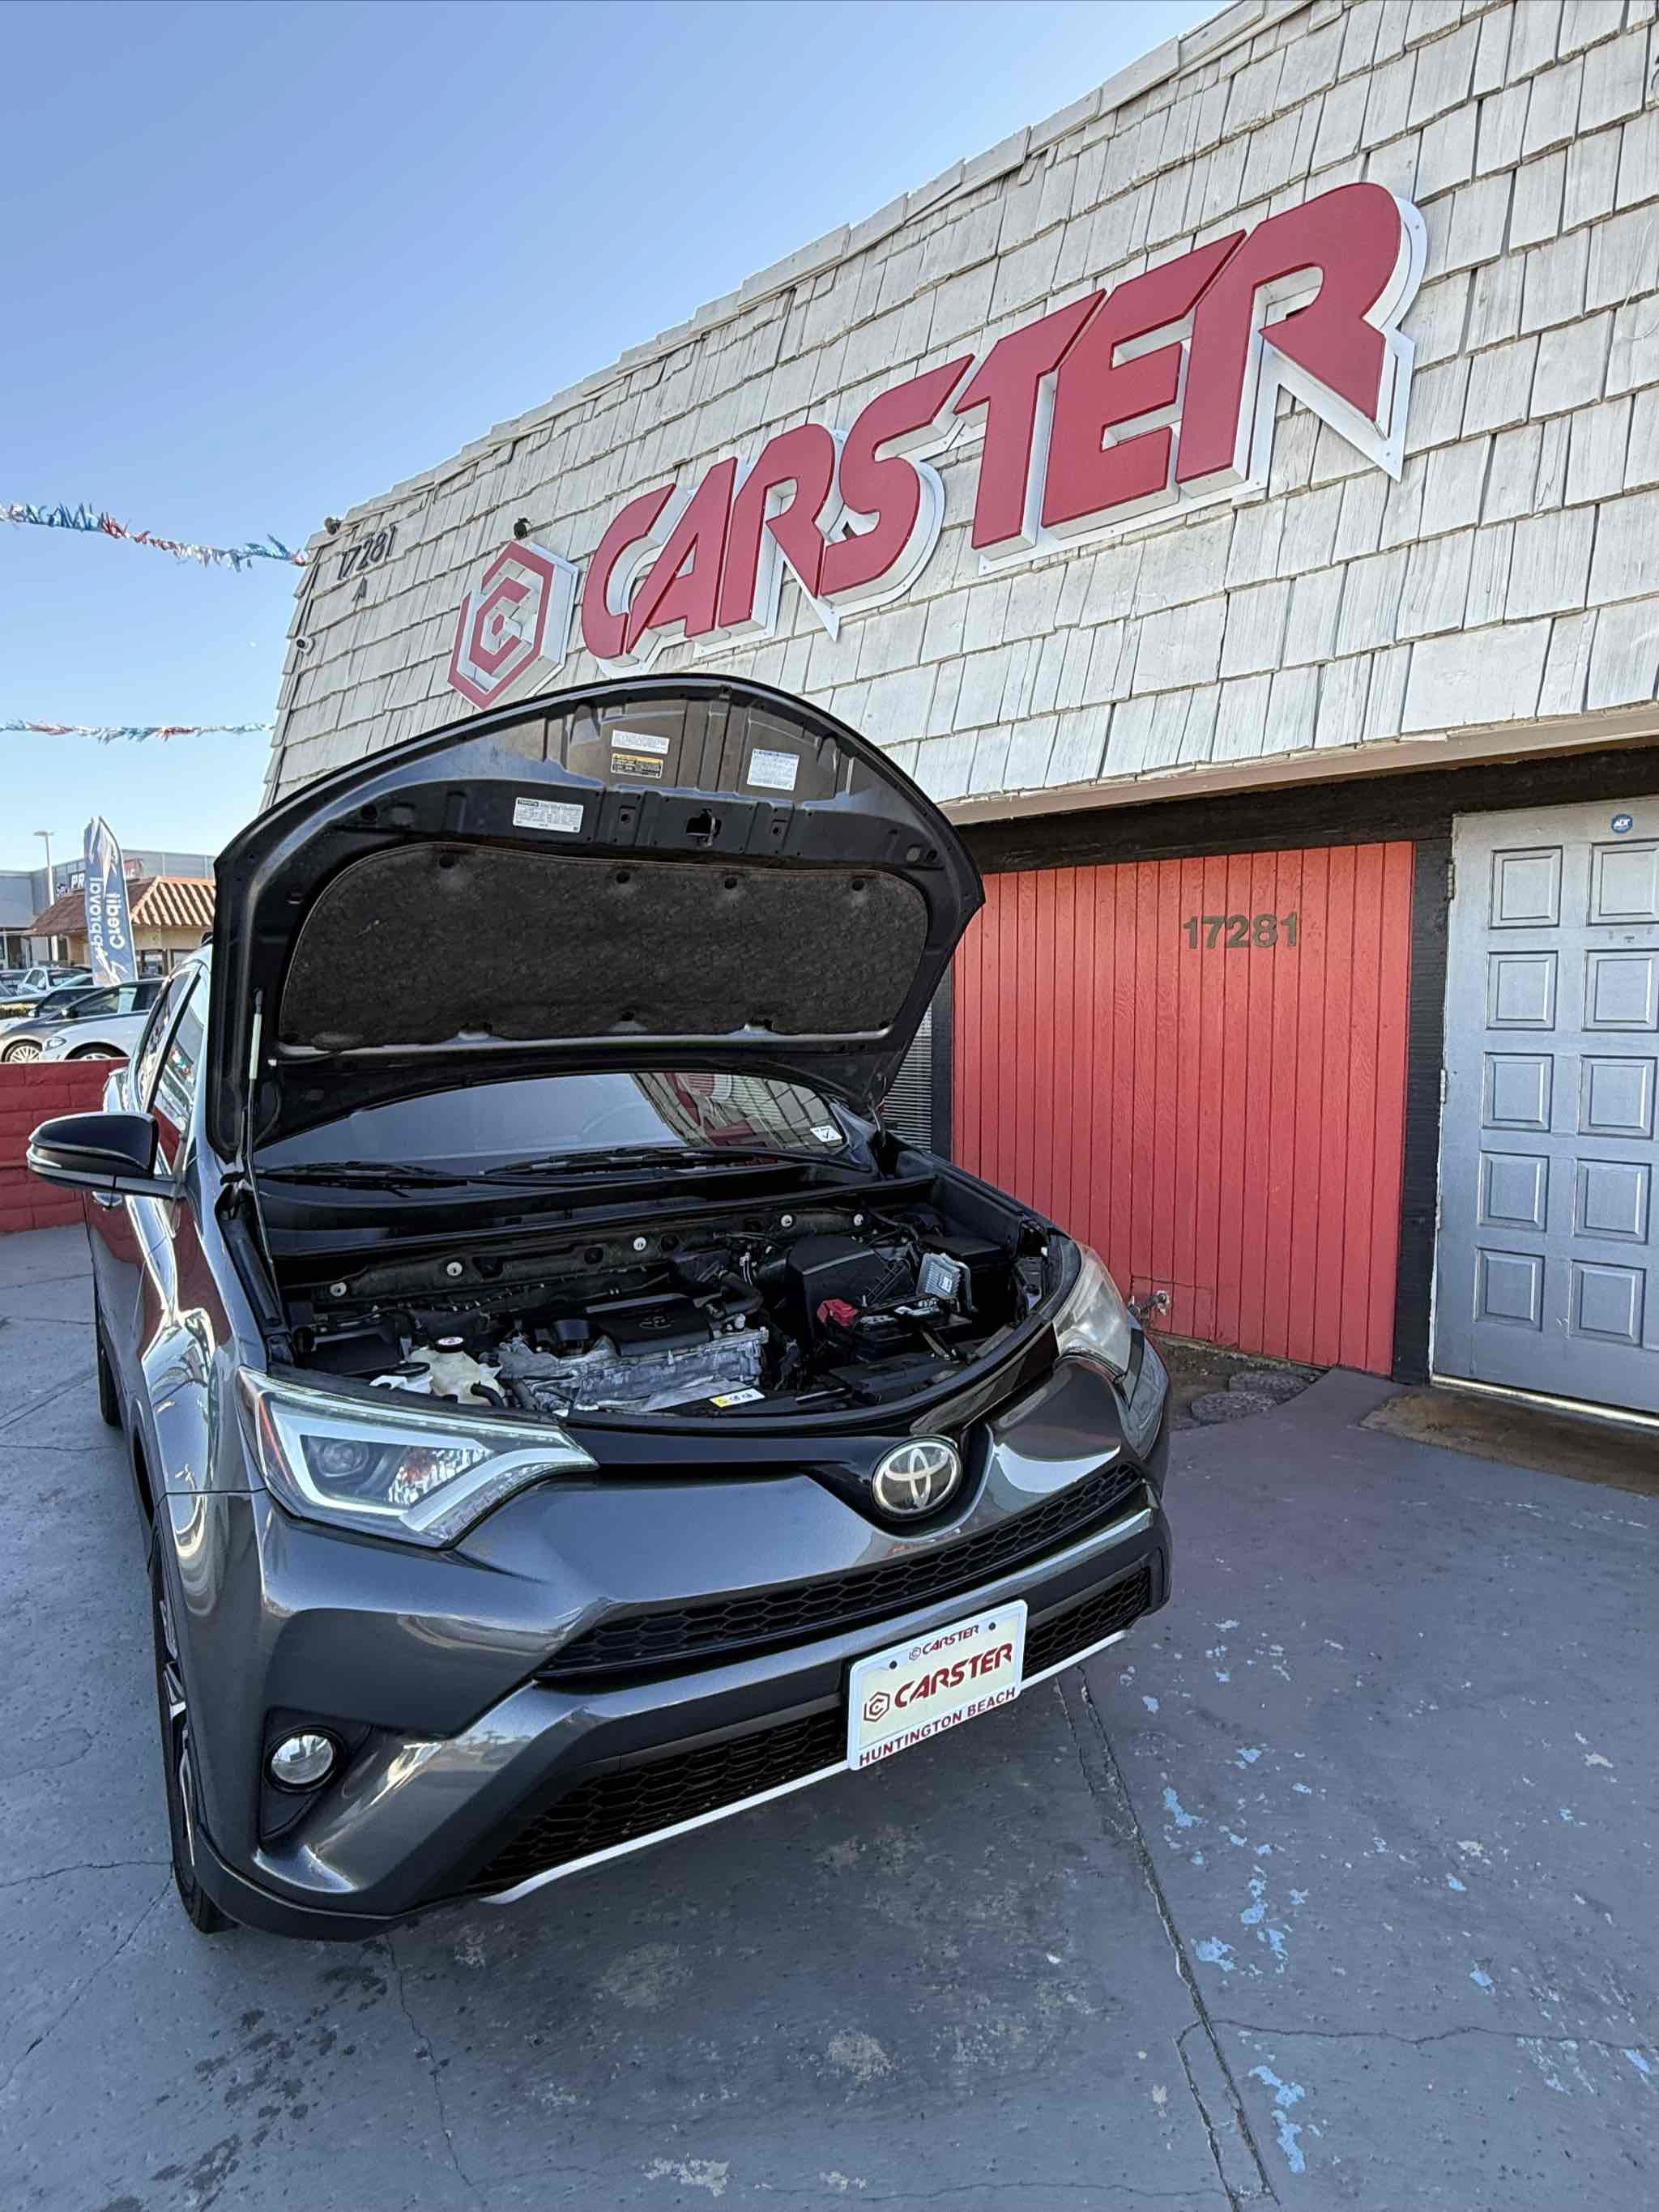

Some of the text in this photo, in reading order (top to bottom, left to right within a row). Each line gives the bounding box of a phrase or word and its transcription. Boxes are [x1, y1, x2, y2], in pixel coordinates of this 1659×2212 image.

[582, 182, 1403, 660] CARSTER
[337, 526, 397, 580] 17281
[1183, 911, 1297, 949] 17281
[922, 1625, 979, 1655] CARSTER
[894, 1643, 1013, 1708] CARSTER
[859, 1687, 1016, 1767] HUNTINGTON BEACH
